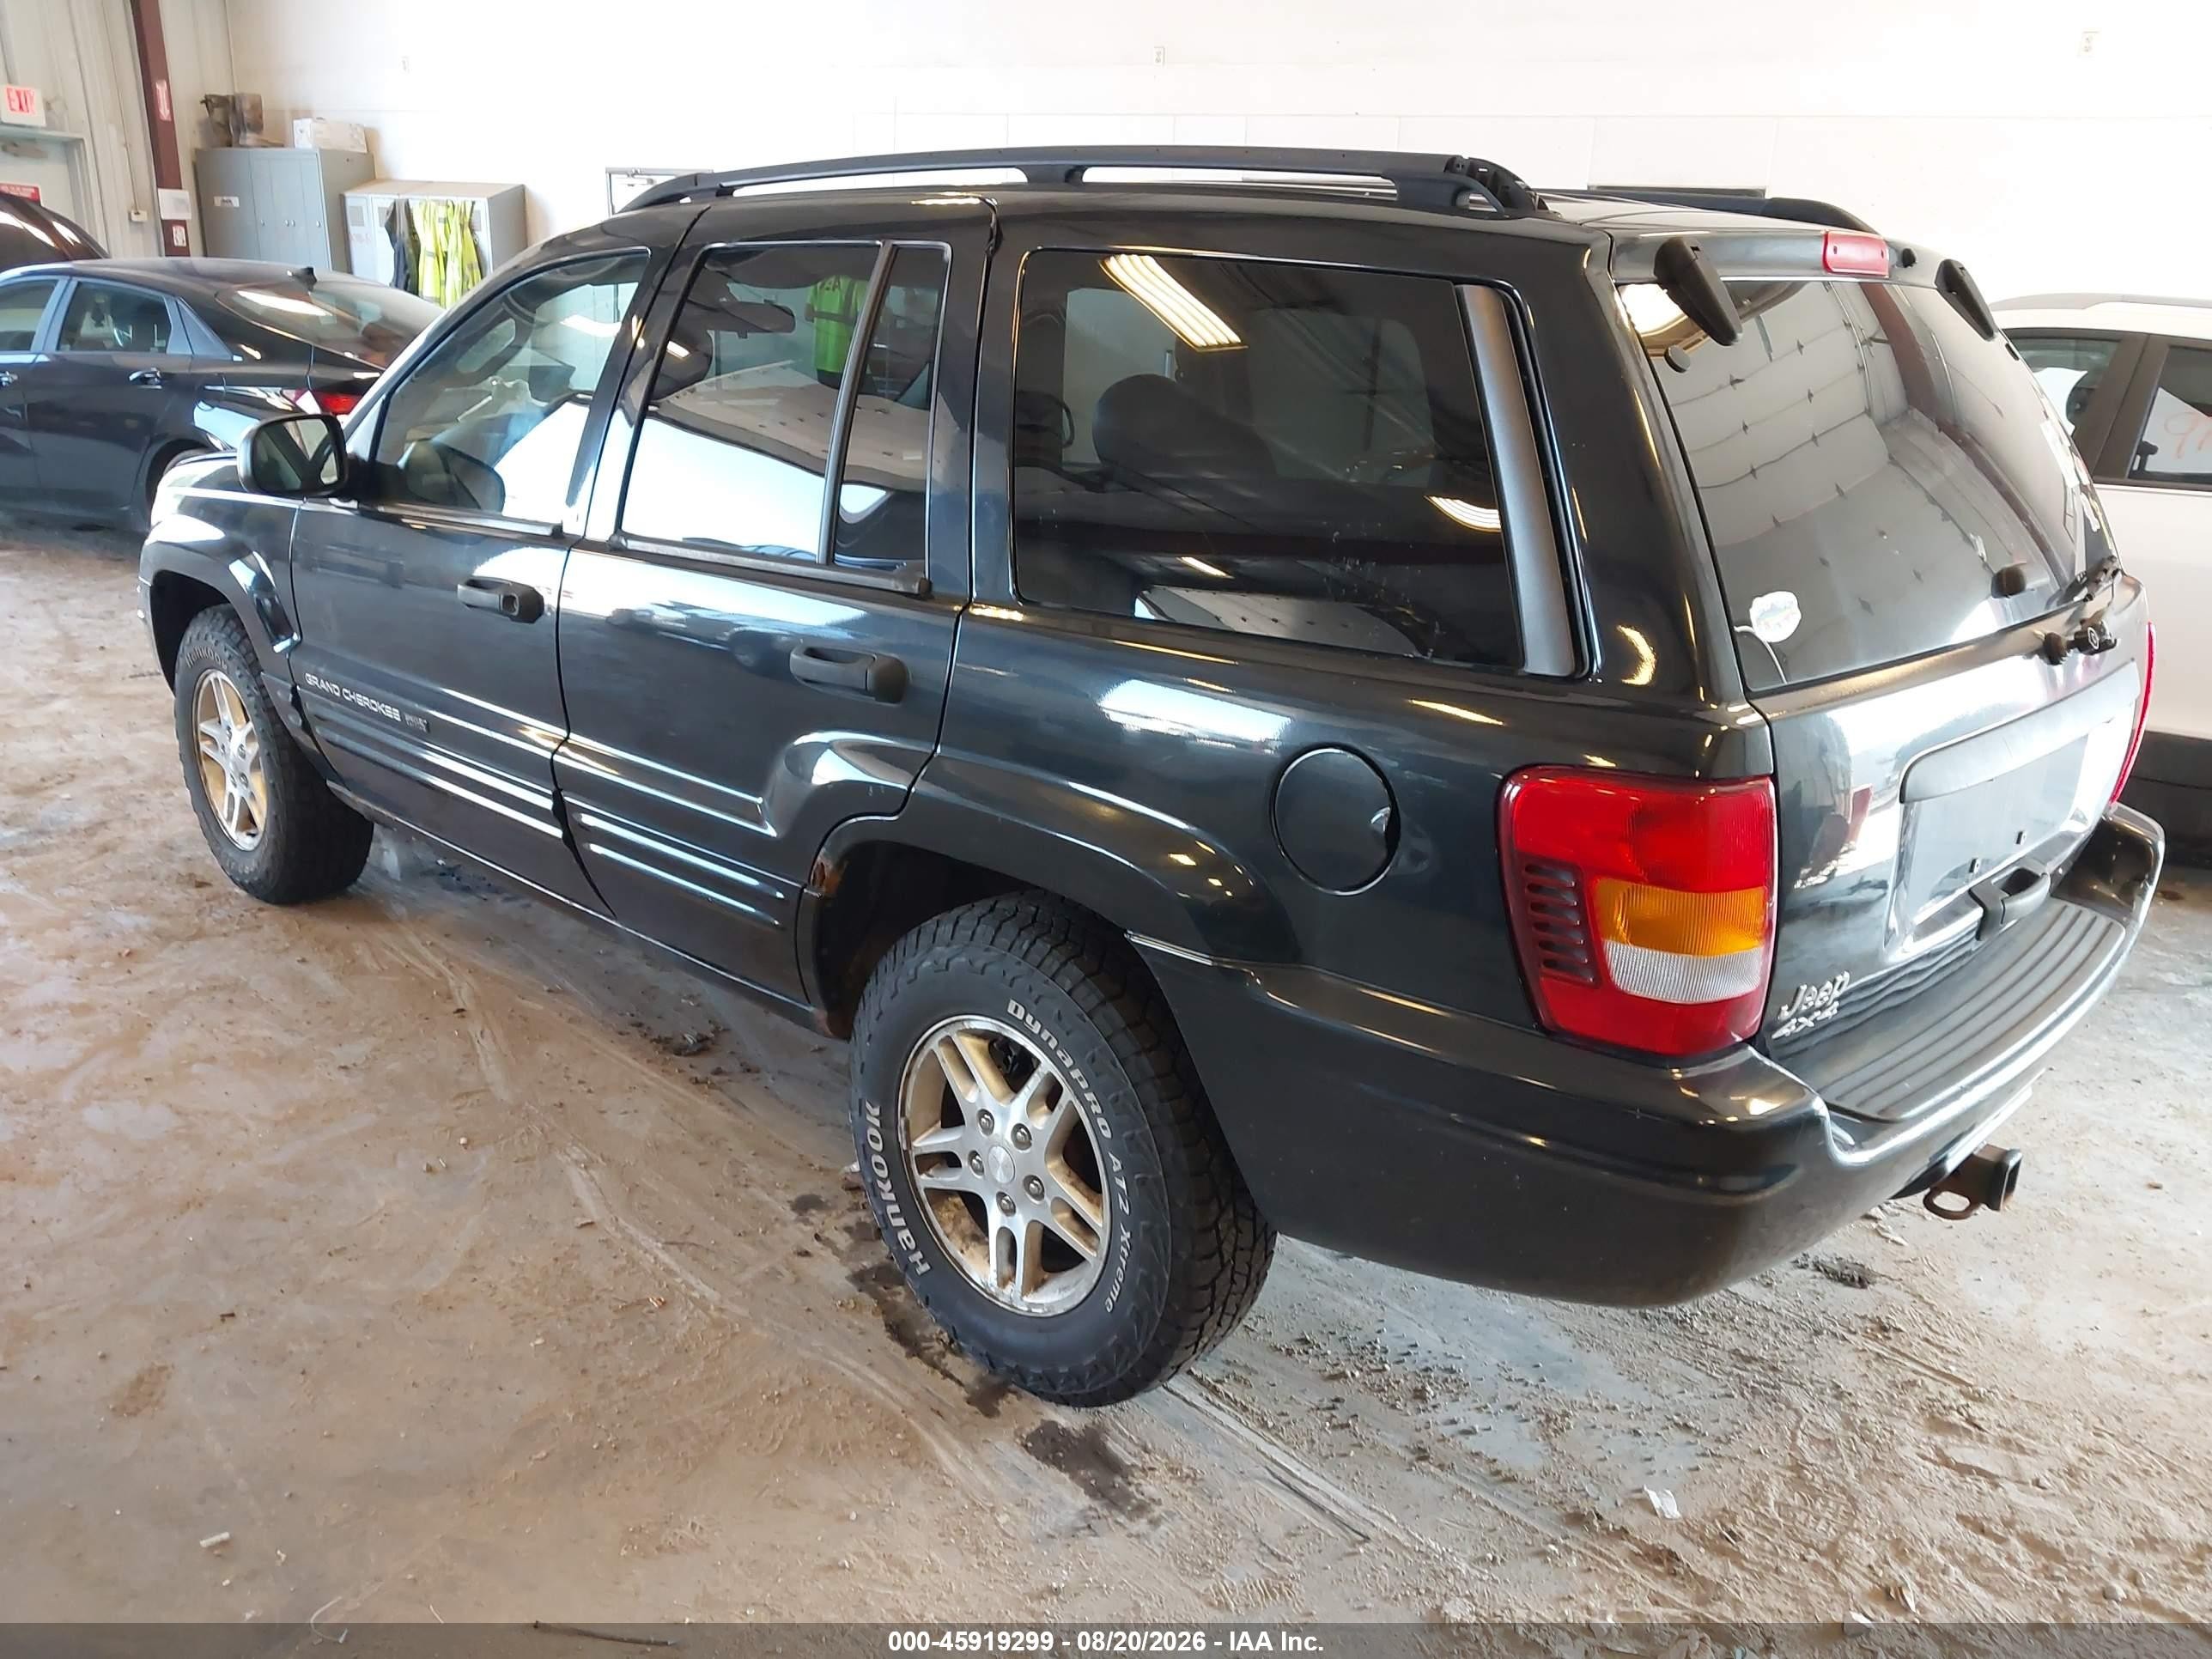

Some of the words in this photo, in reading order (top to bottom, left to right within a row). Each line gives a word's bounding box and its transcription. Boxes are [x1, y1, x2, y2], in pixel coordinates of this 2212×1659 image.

[6, 88, 35, 113] EXIT
[304, 672, 340, 696] GRAND
[342, 688, 402, 722] CHEROKEE
[1778, 970, 1850, 1020] Jeep
[1108, 1151, 1130, 1216] AT2
[1105, 1223, 1133, 1313] Xtreme
